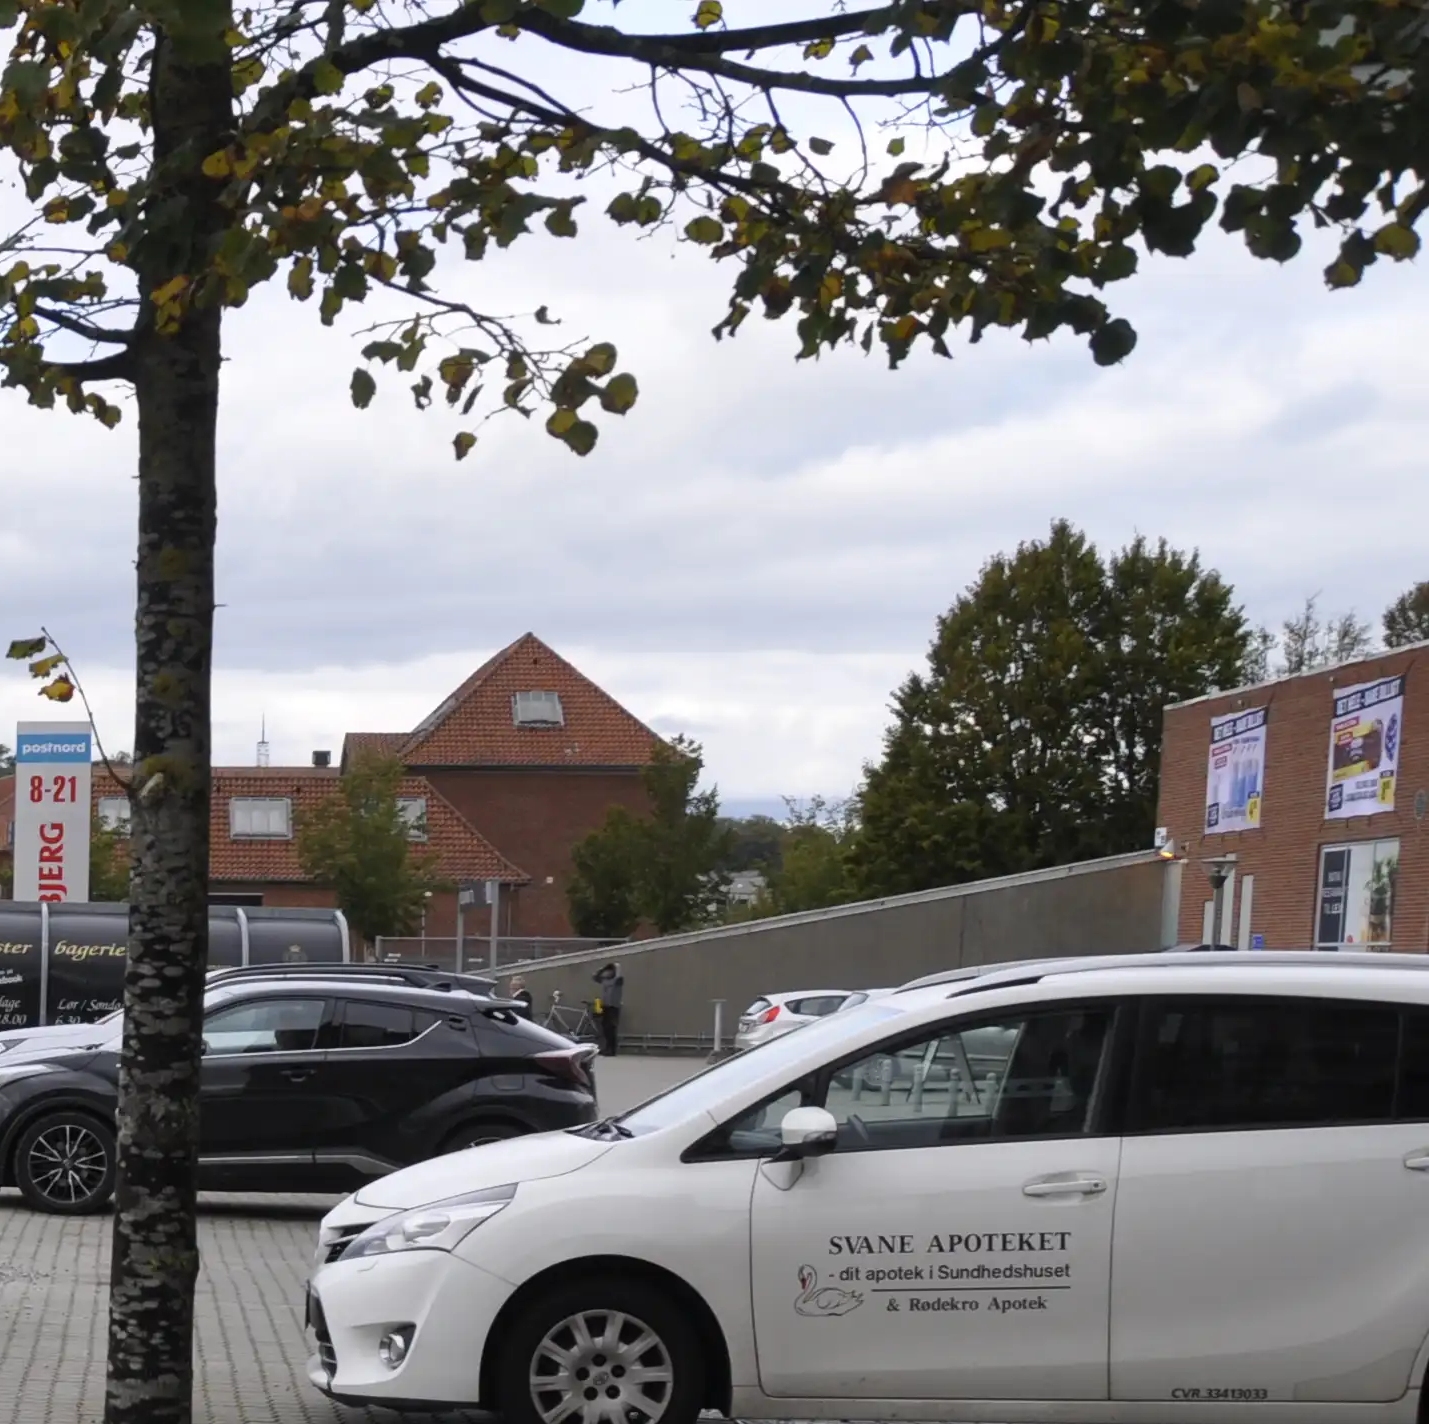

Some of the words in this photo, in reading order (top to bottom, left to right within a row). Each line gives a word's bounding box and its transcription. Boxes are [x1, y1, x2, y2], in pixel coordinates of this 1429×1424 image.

[22, 742, 86, 755] postnord
[30, 775, 77, 803] 8-21
[828, 1235, 914, 1255] SVANE
[927, 1232, 1072, 1253] APOTEKET
[839, 1265, 860, 1281] dit
[865, 1265, 924, 1283] apotek
[929, 1265, 934, 1280] i
[937, 1264, 1071, 1280] Sundhedshuset
[886, 1298, 900, 1312] &
[909, 1297, 979, 1311] Rødekro
[988, 1296, 1048, 1313] Apotek
